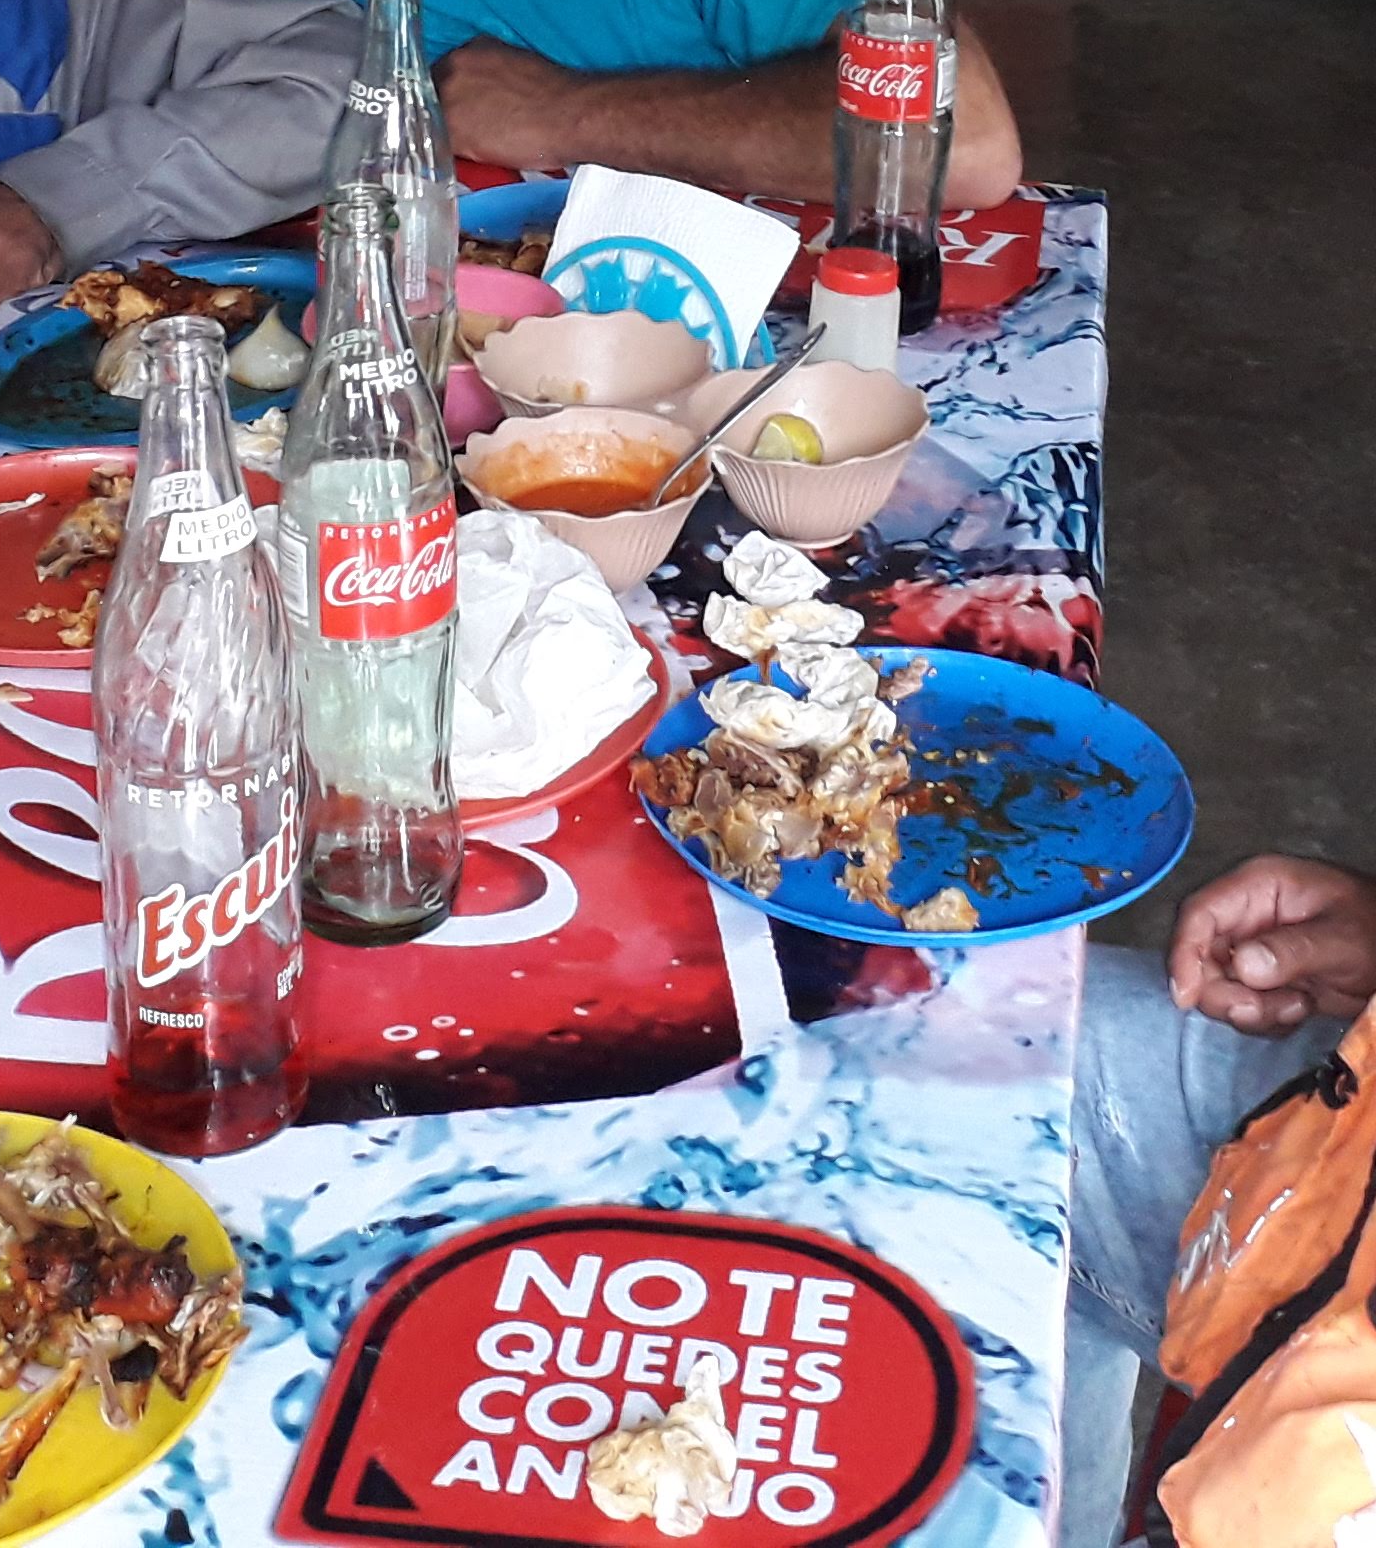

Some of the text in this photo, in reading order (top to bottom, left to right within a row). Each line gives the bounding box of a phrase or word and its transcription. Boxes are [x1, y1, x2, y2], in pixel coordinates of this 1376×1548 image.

[838, 52, 929, 99] Coca-Cola
[340, 348, 415, 381] MEDIO
[346, 367, 418, 399] LITRO
[177, 520, 252, 554] LITRO
[178, 503, 246, 536] MEDIO
[324, 526, 455, 607] Coca-Cola
[127, 753, 292, 810] RETORNAB
[137, 786, 301, 989] Escui
[139, 1005, 204, 1029] REFRESCO
[494, 1248, 856, 1347] NO TE
[432, 1439, 835, 1527] ANJO
